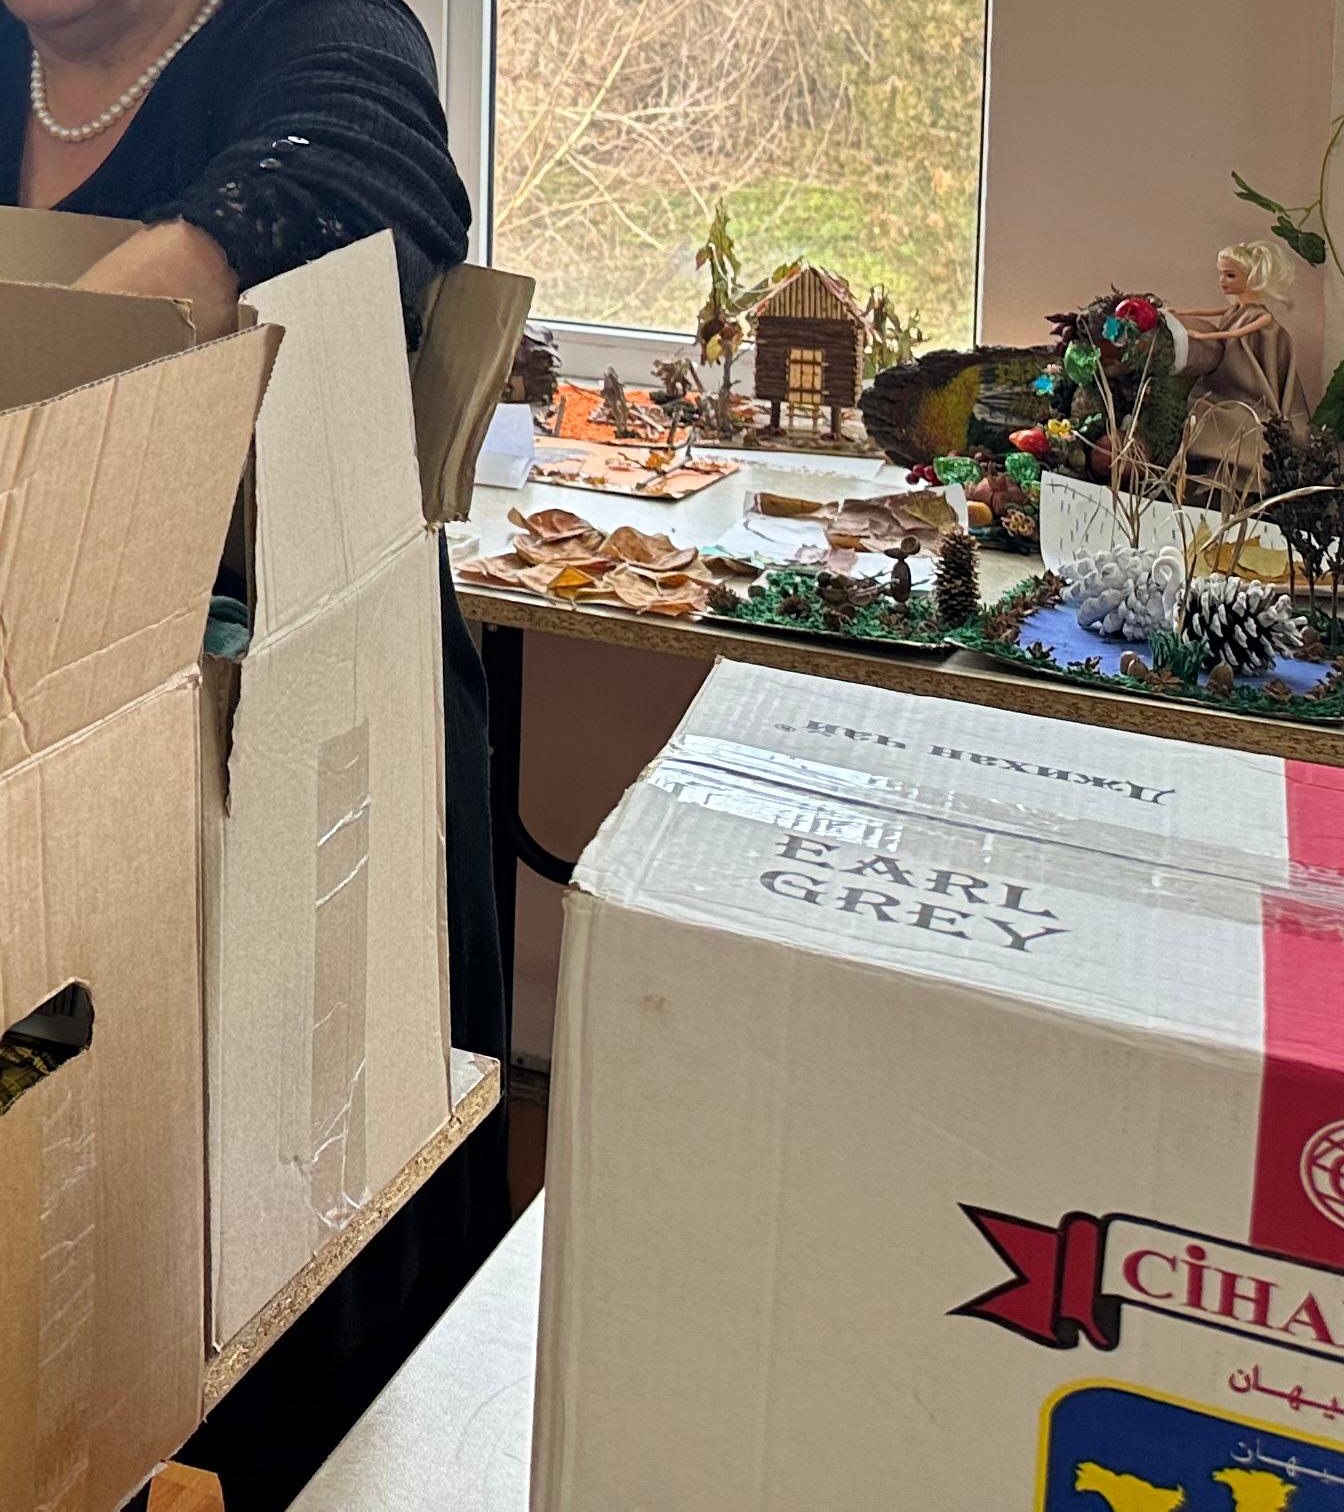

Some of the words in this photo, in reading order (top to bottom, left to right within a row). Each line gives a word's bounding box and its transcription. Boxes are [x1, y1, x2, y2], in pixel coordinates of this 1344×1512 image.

[806, 720, 906, 749] чай
[929, 744, 1175, 806] Джихан
[760, 870, 1072, 953] GREY
[774, 833, 1060, 920] EARL
